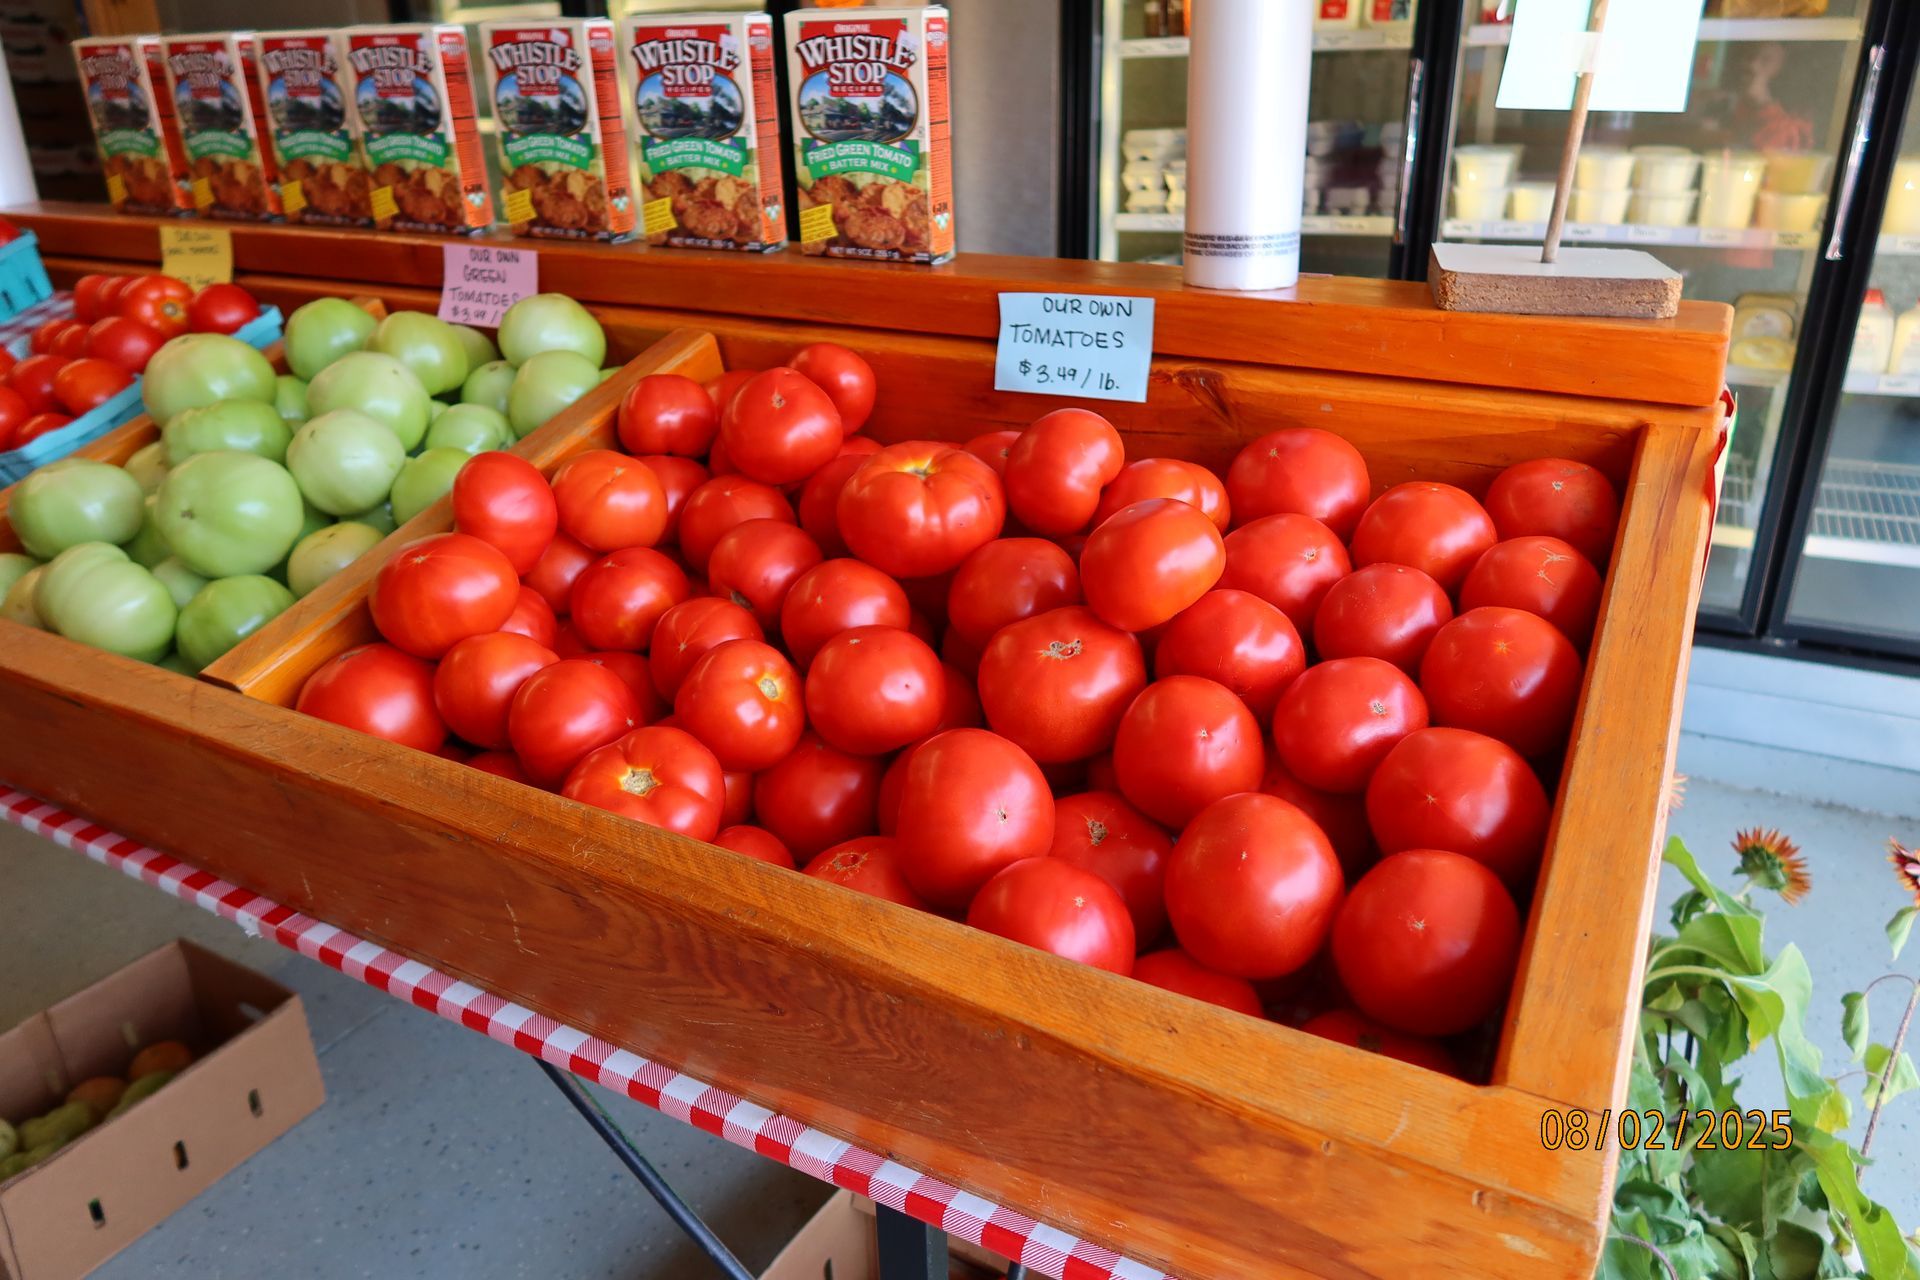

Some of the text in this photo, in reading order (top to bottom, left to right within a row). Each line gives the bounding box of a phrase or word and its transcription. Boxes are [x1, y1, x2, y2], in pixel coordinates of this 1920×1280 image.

[349, 46, 430, 73] WHISTLE
[490, 42, 578, 71] WHISTLE
[632, 39, 735, 71] WHISTLE
[797, 35, 912, 69] WHISTLE
[374, 69, 416, 87] STOP
[517, 65, 561, 85] STOP
[663, 64, 715, 86] STOP
[829, 62, 888, 84] STOP
[666, 154, 720, 167] BATTER MIX
[671, 140, 703, 152] GREEN
[704, 140, 742, 163] TOMATO
[807, 142, 913, 168] FRIED GREEN TOMATO
[829, 157, 889, 172] BATTER MIX
[469, 247, 520, 264] OUR OWN
[463, 264, 506, 284] GREEN
[1043, 297, 1133, 318] OUR OWN
[1009, 323, 1125, 349] TOMATOES
